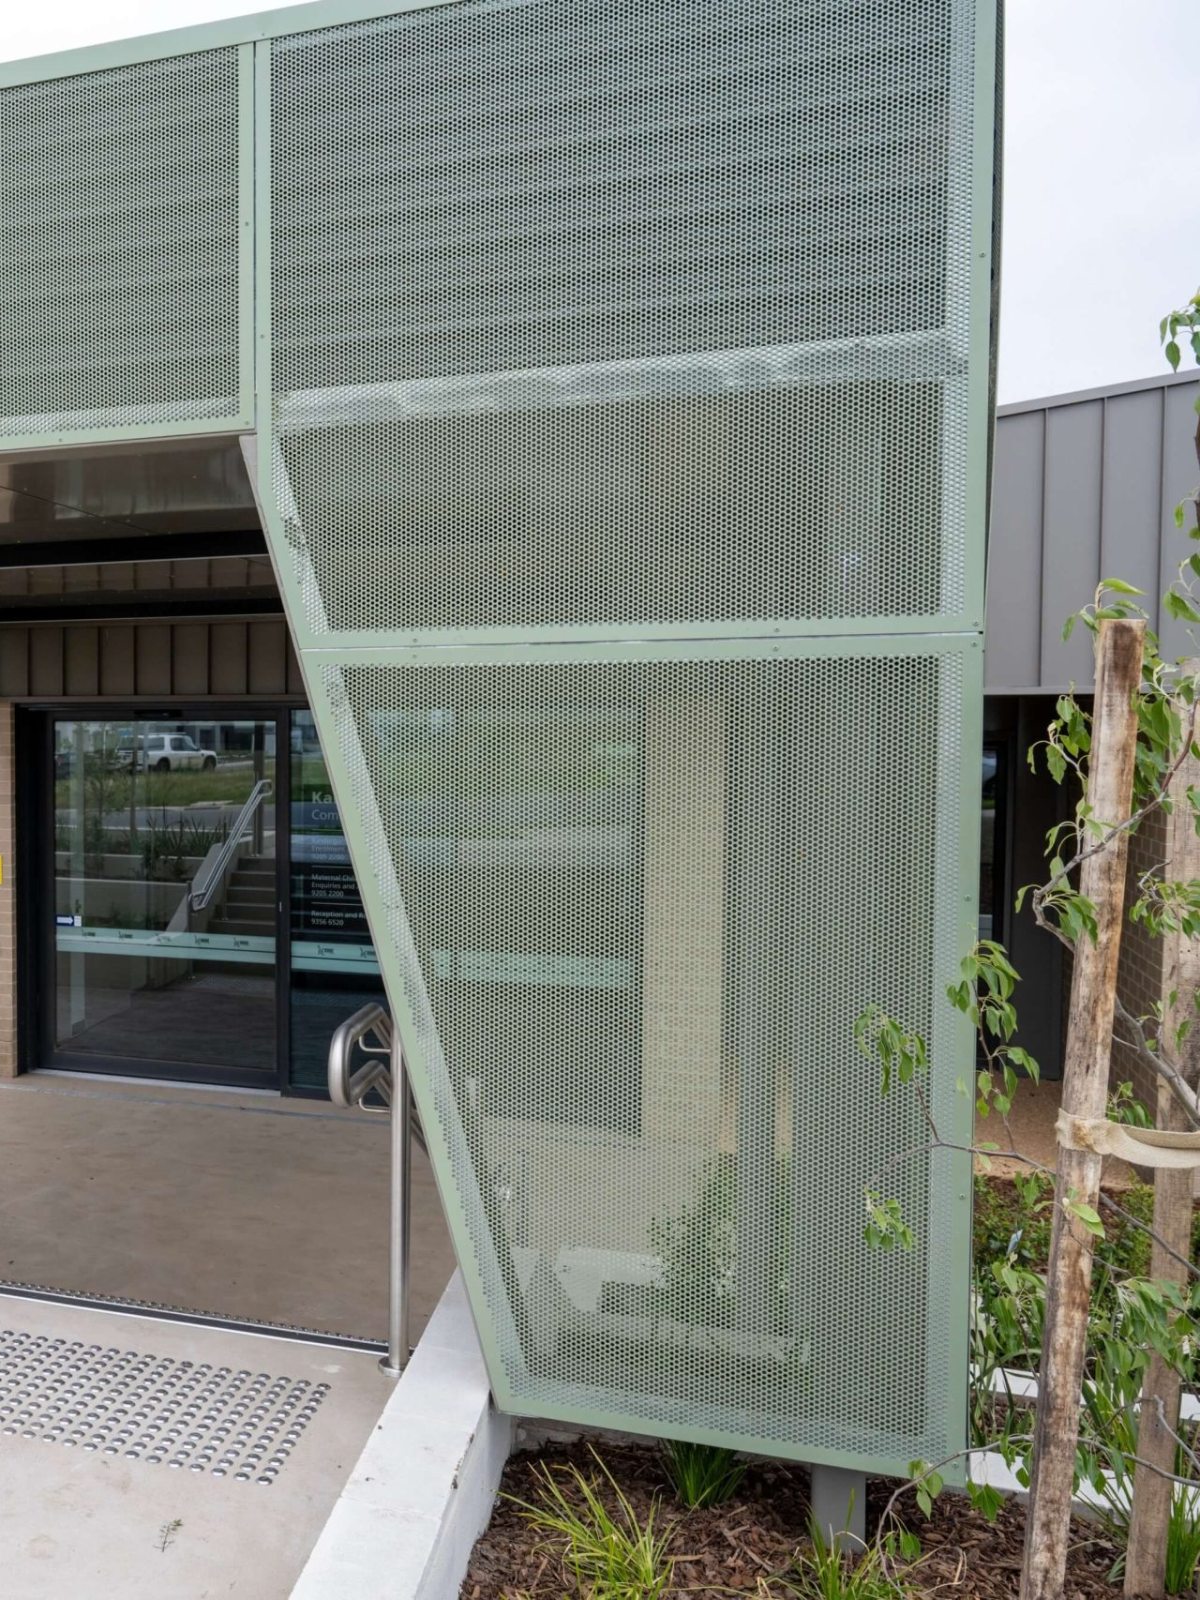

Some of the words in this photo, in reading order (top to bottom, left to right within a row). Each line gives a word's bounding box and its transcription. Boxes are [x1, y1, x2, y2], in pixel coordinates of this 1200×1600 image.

[311, 791, 335, 804] Ka
[311, 882, 341, 890] Enquiries
[311, 911, 343, 919] Reception
